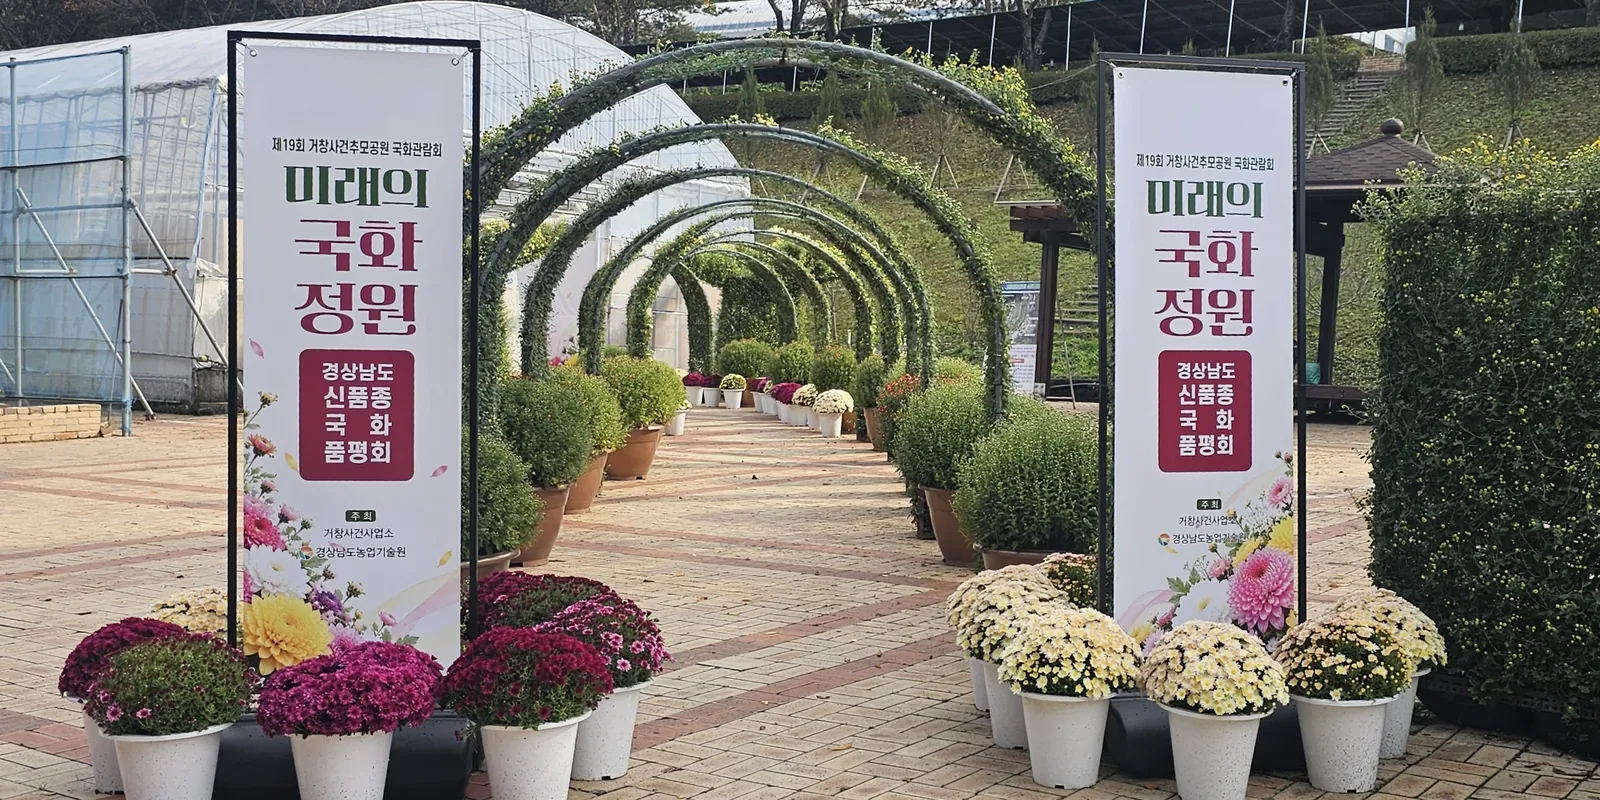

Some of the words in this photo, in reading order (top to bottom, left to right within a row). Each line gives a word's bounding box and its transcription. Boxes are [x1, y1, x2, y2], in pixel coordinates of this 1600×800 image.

[272, 137, 305, 152] 제19회
[308, 138, 389, 156] 거창사건추모공원
[392, 141, 443, 158] 국화관람회
[1136, 153, 1164, 167] 제19회
[1166, 154, 1232, 170] 거창사건추모공원
[1234, 156, 1275, 171] 국화관람회
[283, 165, 429, 208] 미래의
[1146, 179, 1264, 219] 미래의
[294, 219, 423, 272] 국화
[1155, 229, 1259, 278] 국화
[294, 282, 419, 336] 정원
[1154, 288, 1255, 337] 정원
[322, 362, 394, 382] 경상남도
[1177, 362, 1236, 380] 경상남도
[323, 386, 392, 410] 신품종
[1178, 384, 1235, 405] 신품종
[324, 440, 391, 464] 품평회
[1178, 434, 1235, 456] 품평회
[1178, 515, 1237, 527] 거창사건사업소
[323, 527, 394, 539] 거창사건사업소
[1172, 532, 1247, 544] 경상남도농업기술원
[315, 545, 406, 558] 경상남도농업기술원
